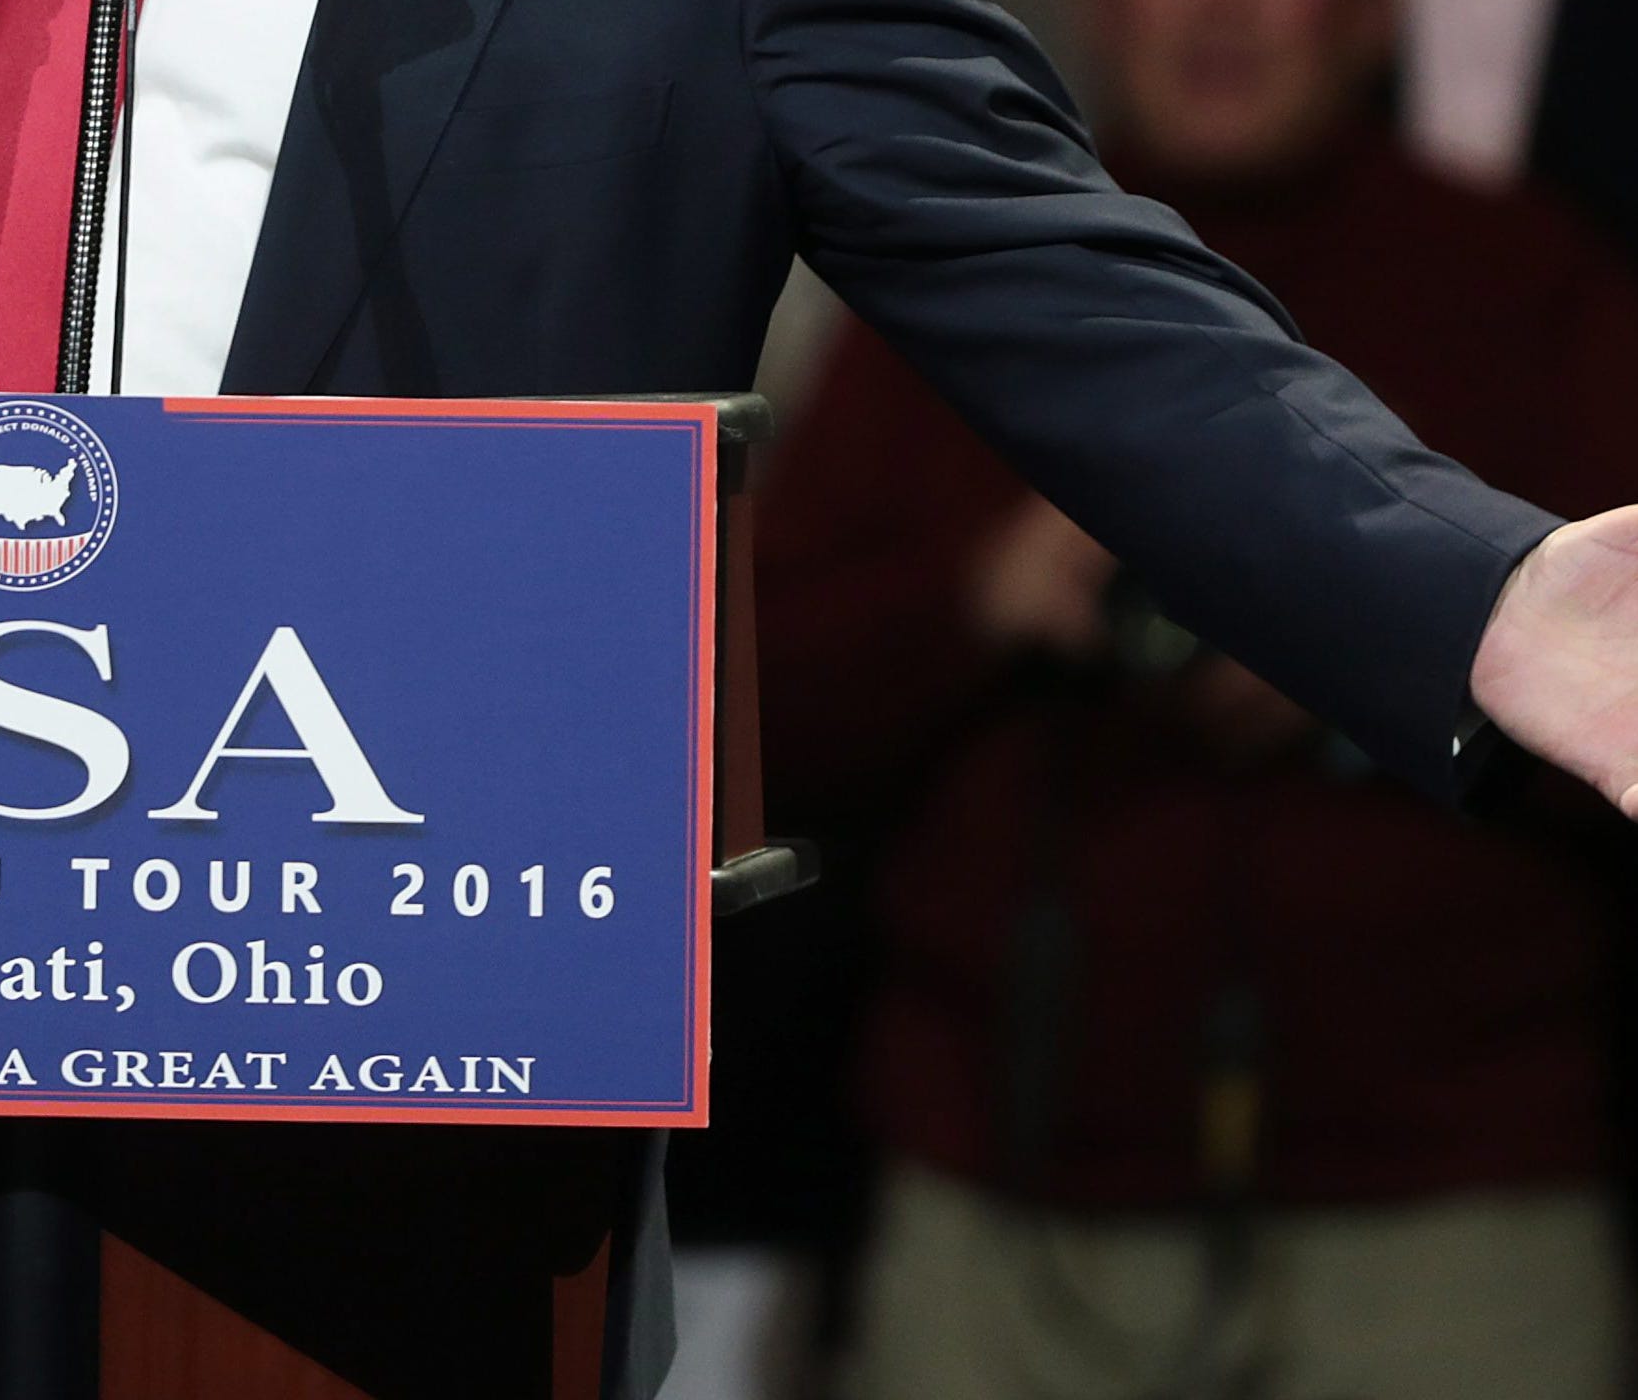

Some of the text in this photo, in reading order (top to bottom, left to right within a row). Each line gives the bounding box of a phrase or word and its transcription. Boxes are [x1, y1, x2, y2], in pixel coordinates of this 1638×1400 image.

[21, 422, 70, 444] DONALD
[77, 452, 98, 502] TRUMP
[71, 858, 322, 914] TOUR
[390, 863, 614, 919] 2016
[172, 939, 383, 1006] Ohio
[61, 1049, 287, 1090] GREAT
[309, 1054, 536, 1094] AGAIN
